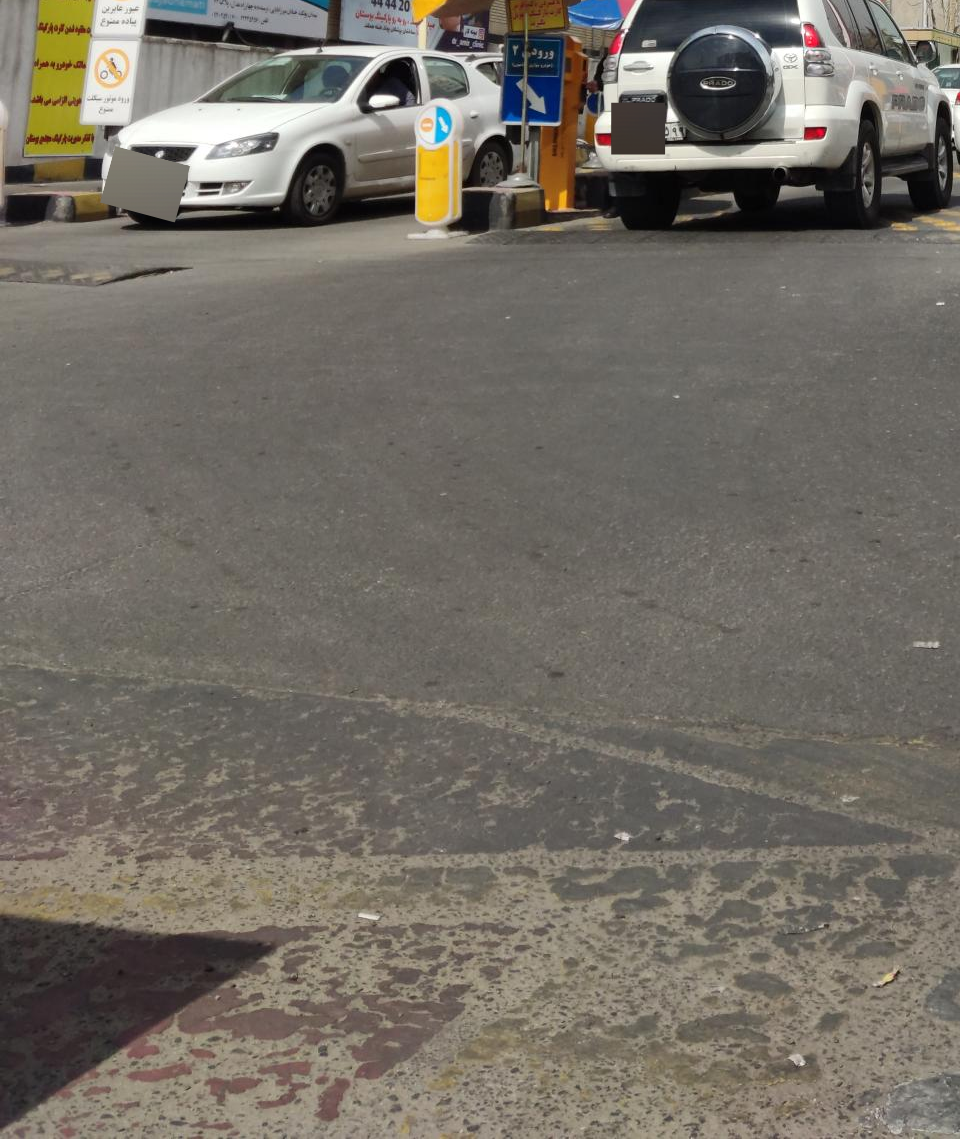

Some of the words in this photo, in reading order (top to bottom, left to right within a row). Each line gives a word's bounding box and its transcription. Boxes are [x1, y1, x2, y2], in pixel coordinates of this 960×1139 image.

[102, 4, 122, 15] عابرین
[125, 5, 140, 15] عبور
[398, 0, 410, 12] 20
[100, 18, 120, 27] ممنوع
[121, 18, 137, 27] پیاده
[512, 45, 519, 56] ۲
[702, 79, 733, 87] PRADO
[892, 94, 926, 111] PRADO
